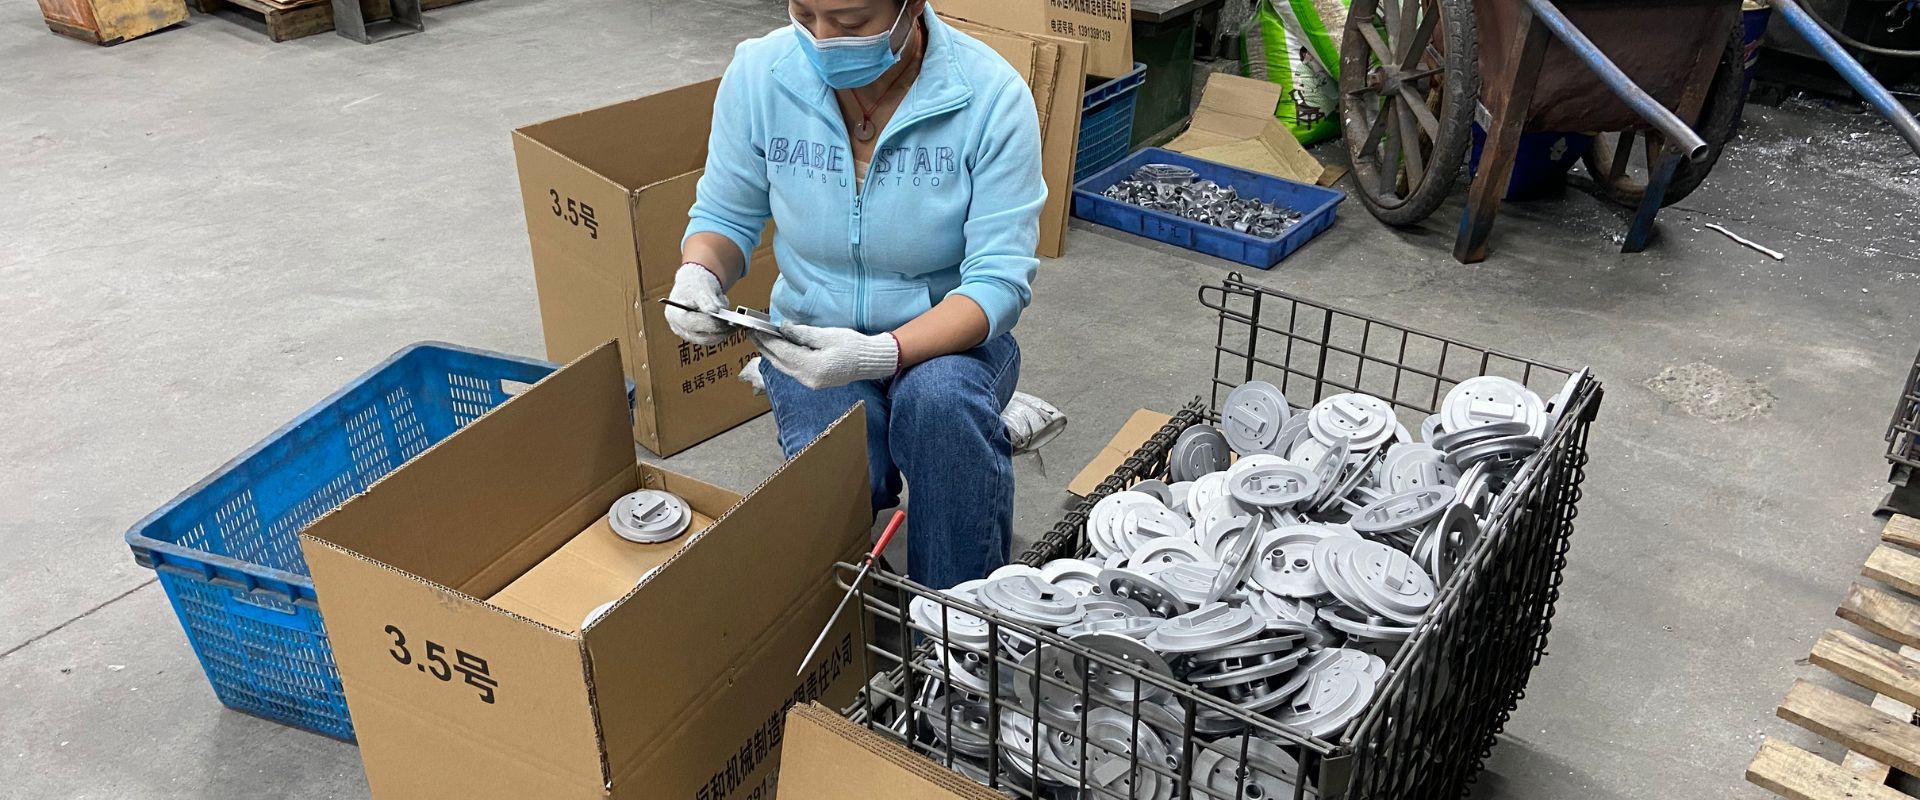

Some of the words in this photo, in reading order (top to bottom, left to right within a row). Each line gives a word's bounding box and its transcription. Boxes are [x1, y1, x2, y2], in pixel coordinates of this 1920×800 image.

[768, 137, 845, 172] BABE
[876, 146, 955, 175] STAR
[549, 188, 599, 240] 3.5号
[384, 624, 499, 705] 3.5号
